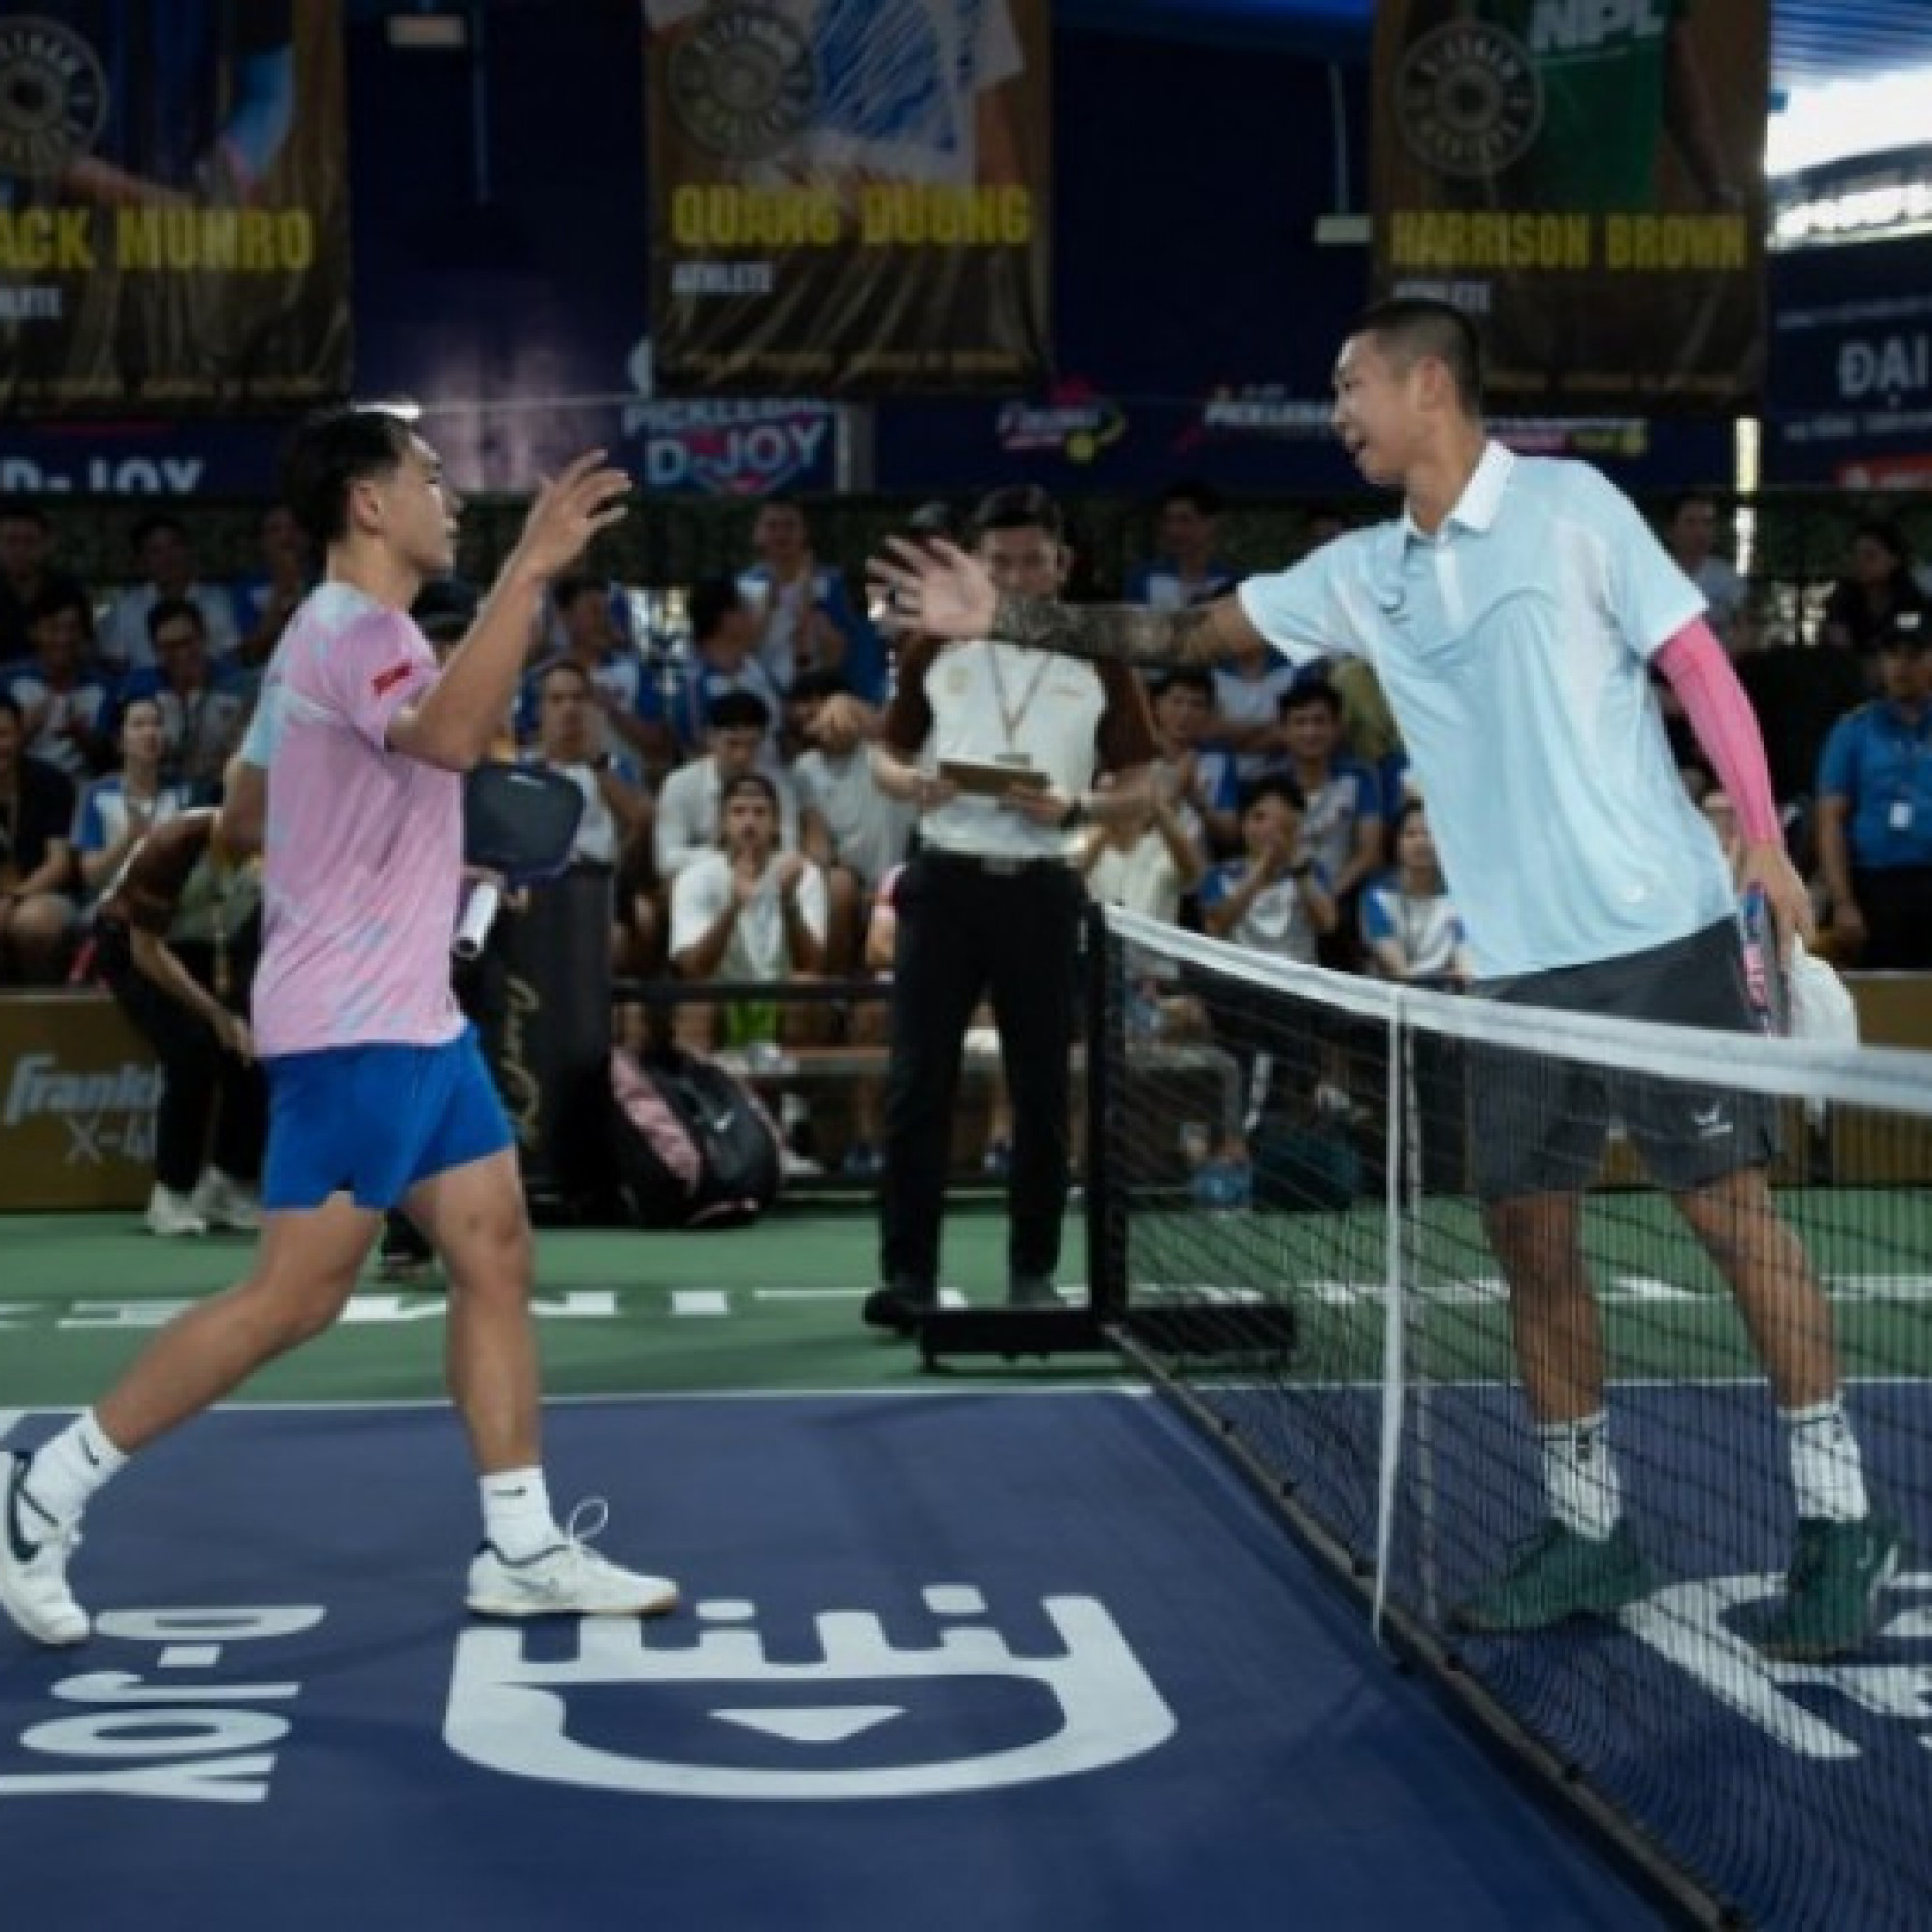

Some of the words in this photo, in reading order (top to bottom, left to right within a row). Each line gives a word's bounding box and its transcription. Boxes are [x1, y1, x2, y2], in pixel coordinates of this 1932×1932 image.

[115, 206, 315, 272] MUNRO
[671, 185, 838, 247] QUANG
[862, 184, 1031, 247] DUONG
[1389, 210, 1592, 268] HARRISON
[1605, 212, 1747, 270] BROWN
[0, 1605, 326, 1803] D-JOY
